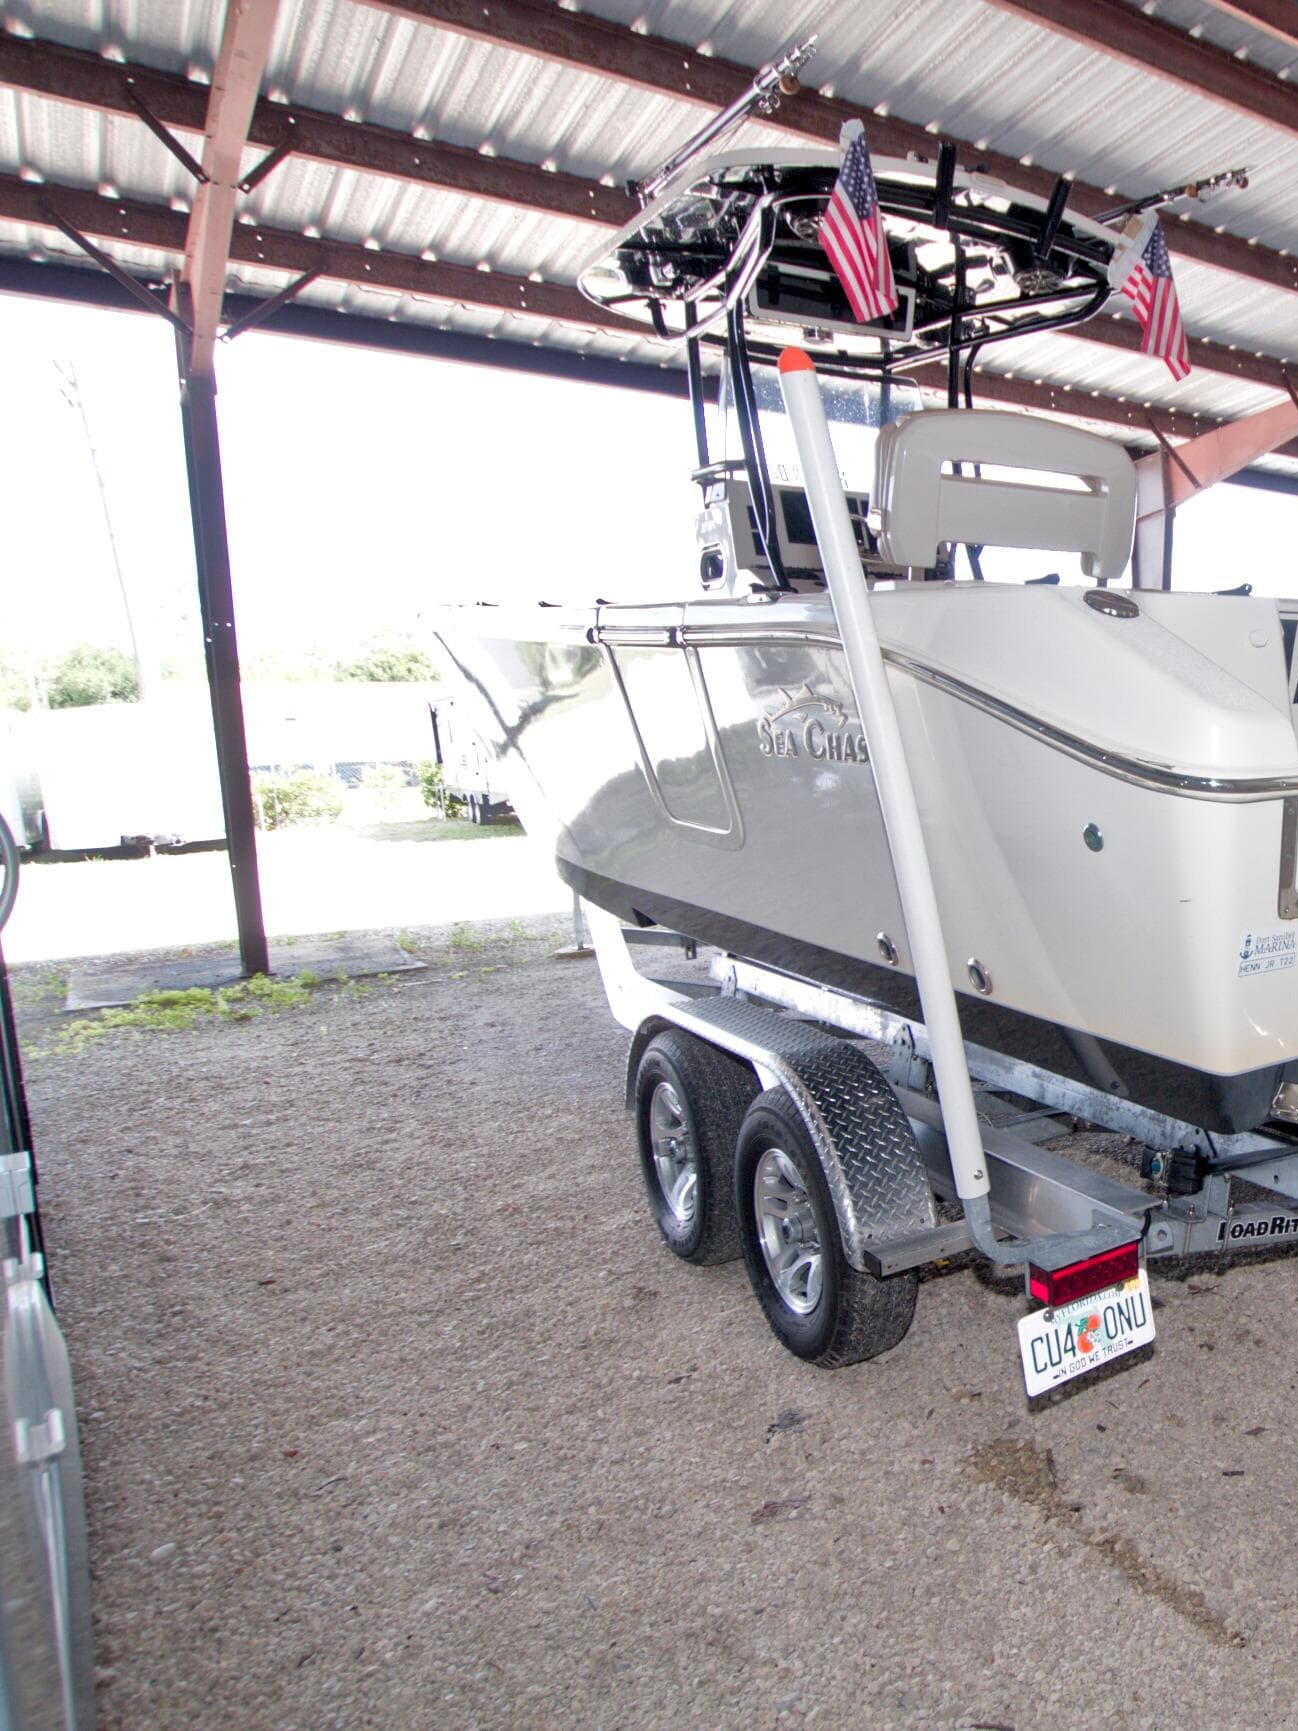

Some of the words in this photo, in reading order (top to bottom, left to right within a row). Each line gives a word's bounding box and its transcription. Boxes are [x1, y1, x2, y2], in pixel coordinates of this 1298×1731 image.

[1254, 939, 1296, 955] MARINA
[1031, 1322, 1076, 1374] CU4
[1069, 1357, 1088, 1373] GOD
[1089, 1352, 1101, 1364] WE
[1102, 1337, 1129, 1357] TRUST
